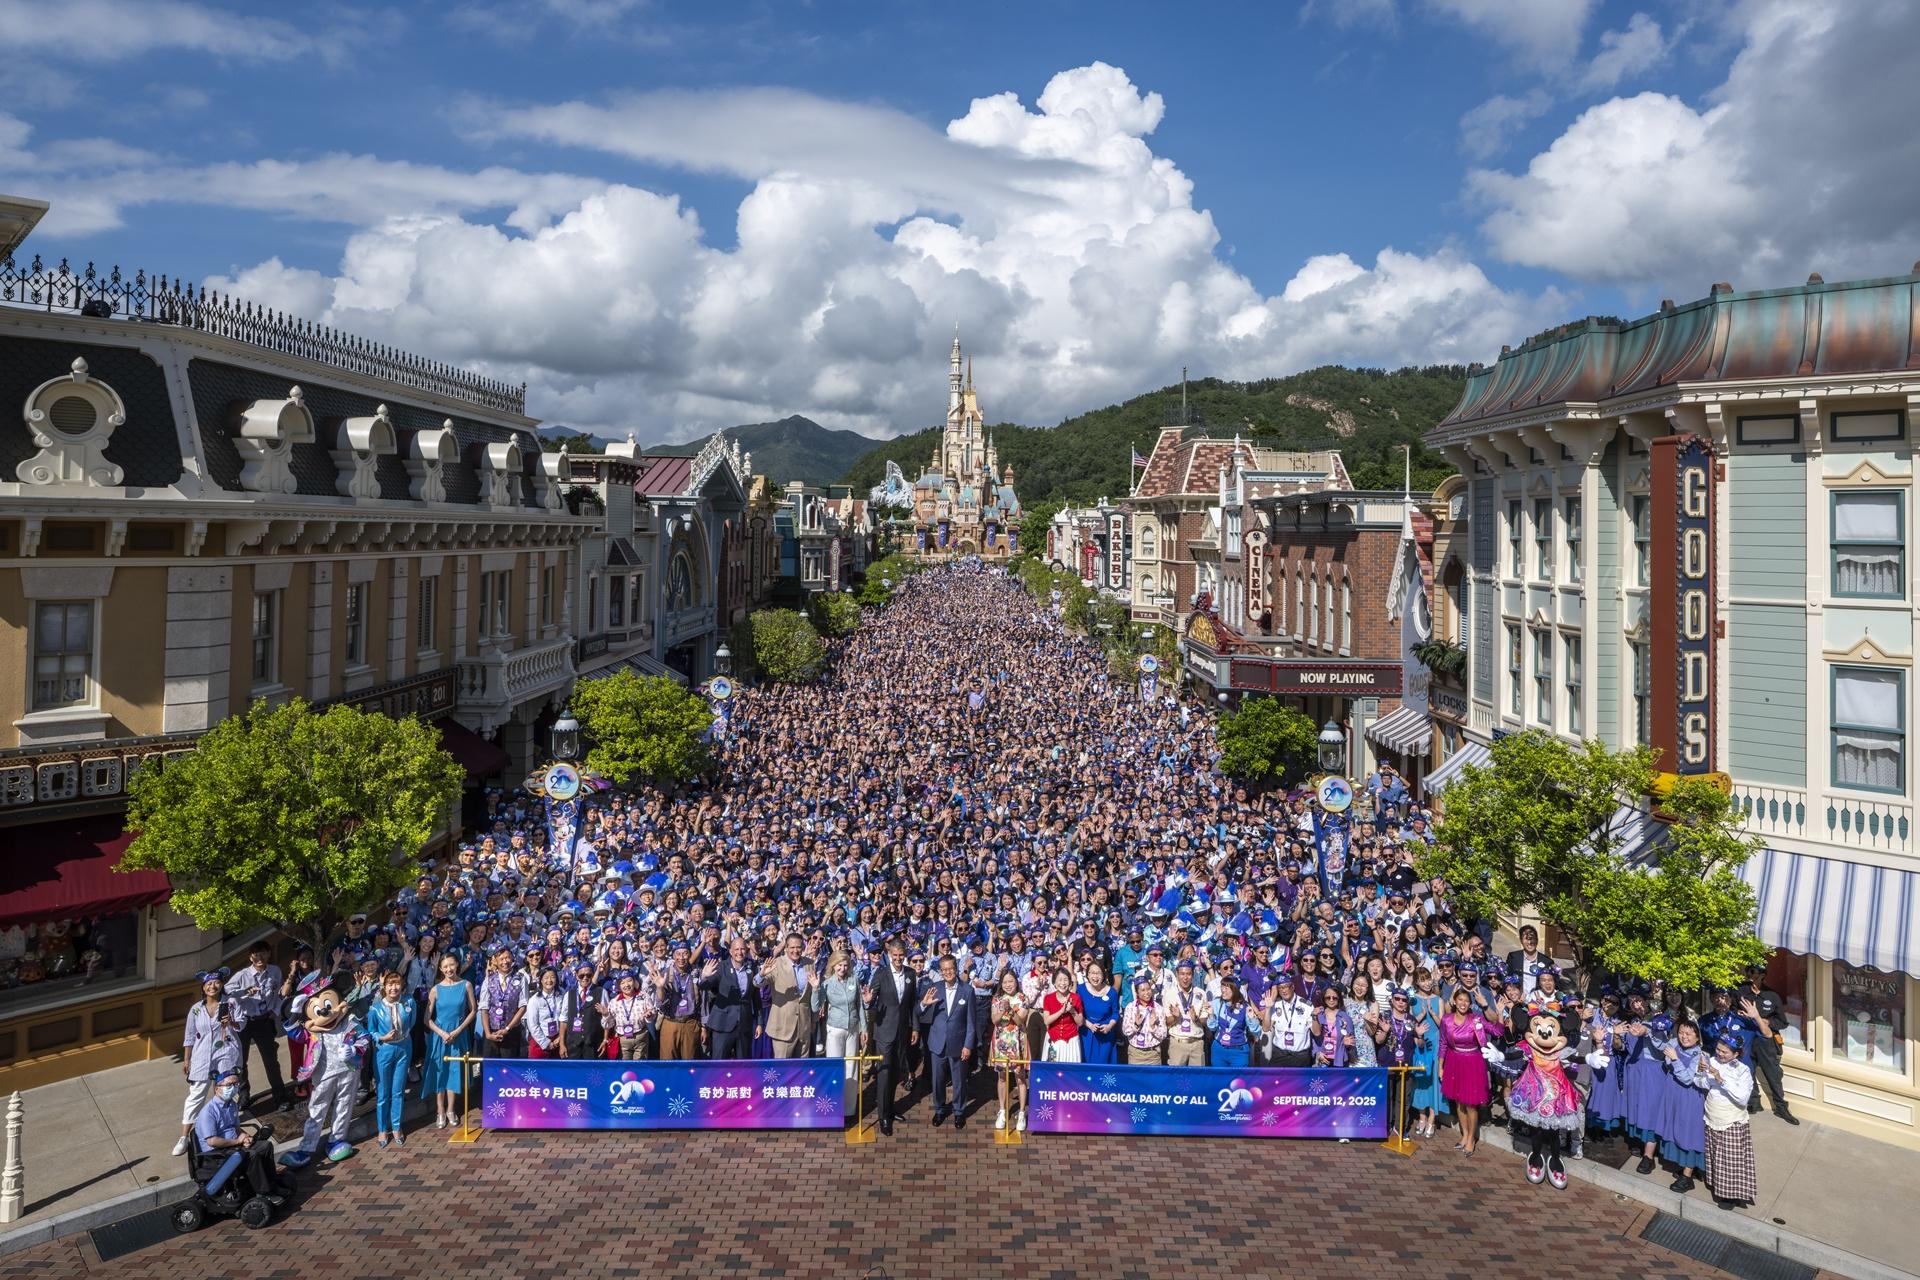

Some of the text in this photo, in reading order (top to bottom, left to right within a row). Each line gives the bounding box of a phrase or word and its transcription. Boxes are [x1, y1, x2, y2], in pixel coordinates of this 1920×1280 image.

[1112, 520, 1122, 585] BAKERY
[1251, 546, 1261, 611] CINEMA
[1683, 466, 1708, 765] GOODS
[1300, 672, 1375, 684] NOW PLAYING
[432, 685, 446, 703] 201
[1841, 973, 1897, 995] MARTY'S
[498, 1086, 588, 1099] 2025年9月12日
[699, 1085, 816, 1099] 奇妙派對 快樂盛放
[1038, 1090, 1208, 1105] THE MOST MAGICAL PARTY OF ALL
[1273, 1095, 1377, 1107] SEPTEMBER 12, 2025
